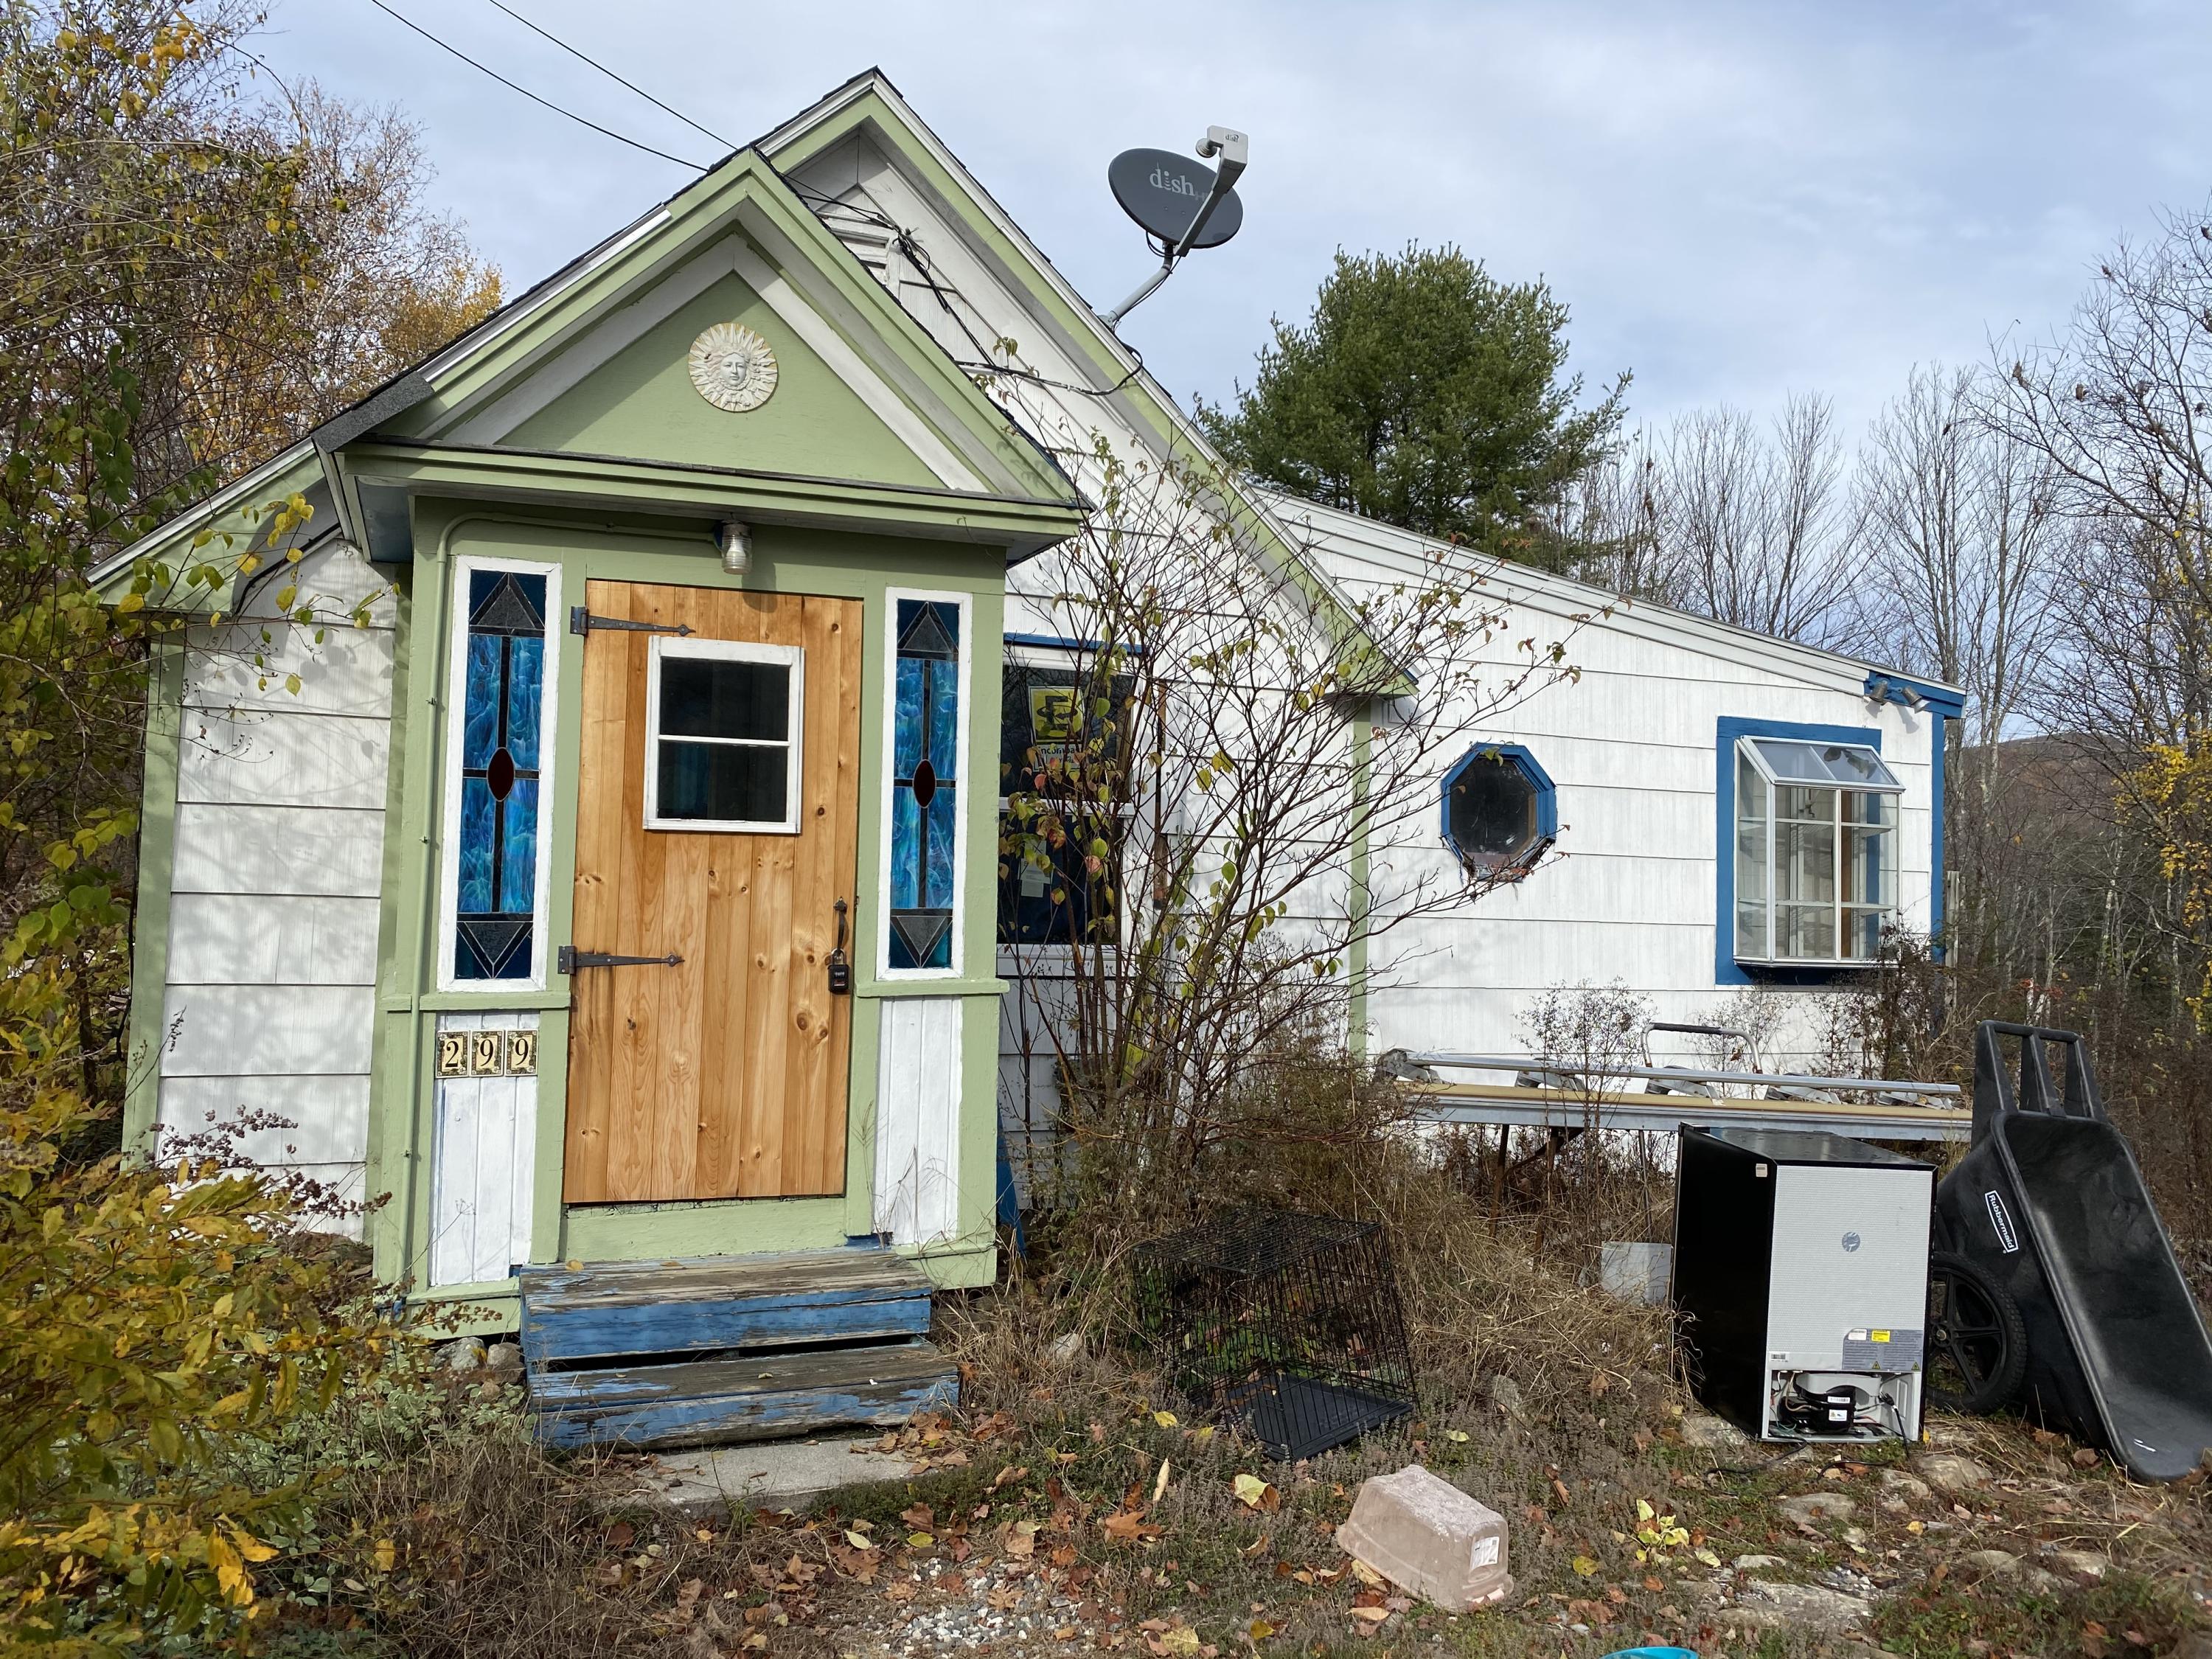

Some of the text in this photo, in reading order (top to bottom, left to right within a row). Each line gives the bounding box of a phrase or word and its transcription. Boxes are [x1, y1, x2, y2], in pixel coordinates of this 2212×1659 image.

[1150, 161, 1195, 197] dish
[445, 1037, 529, 1068] 299
[1989, 1194, 2014, 1248] Rubbermaid
